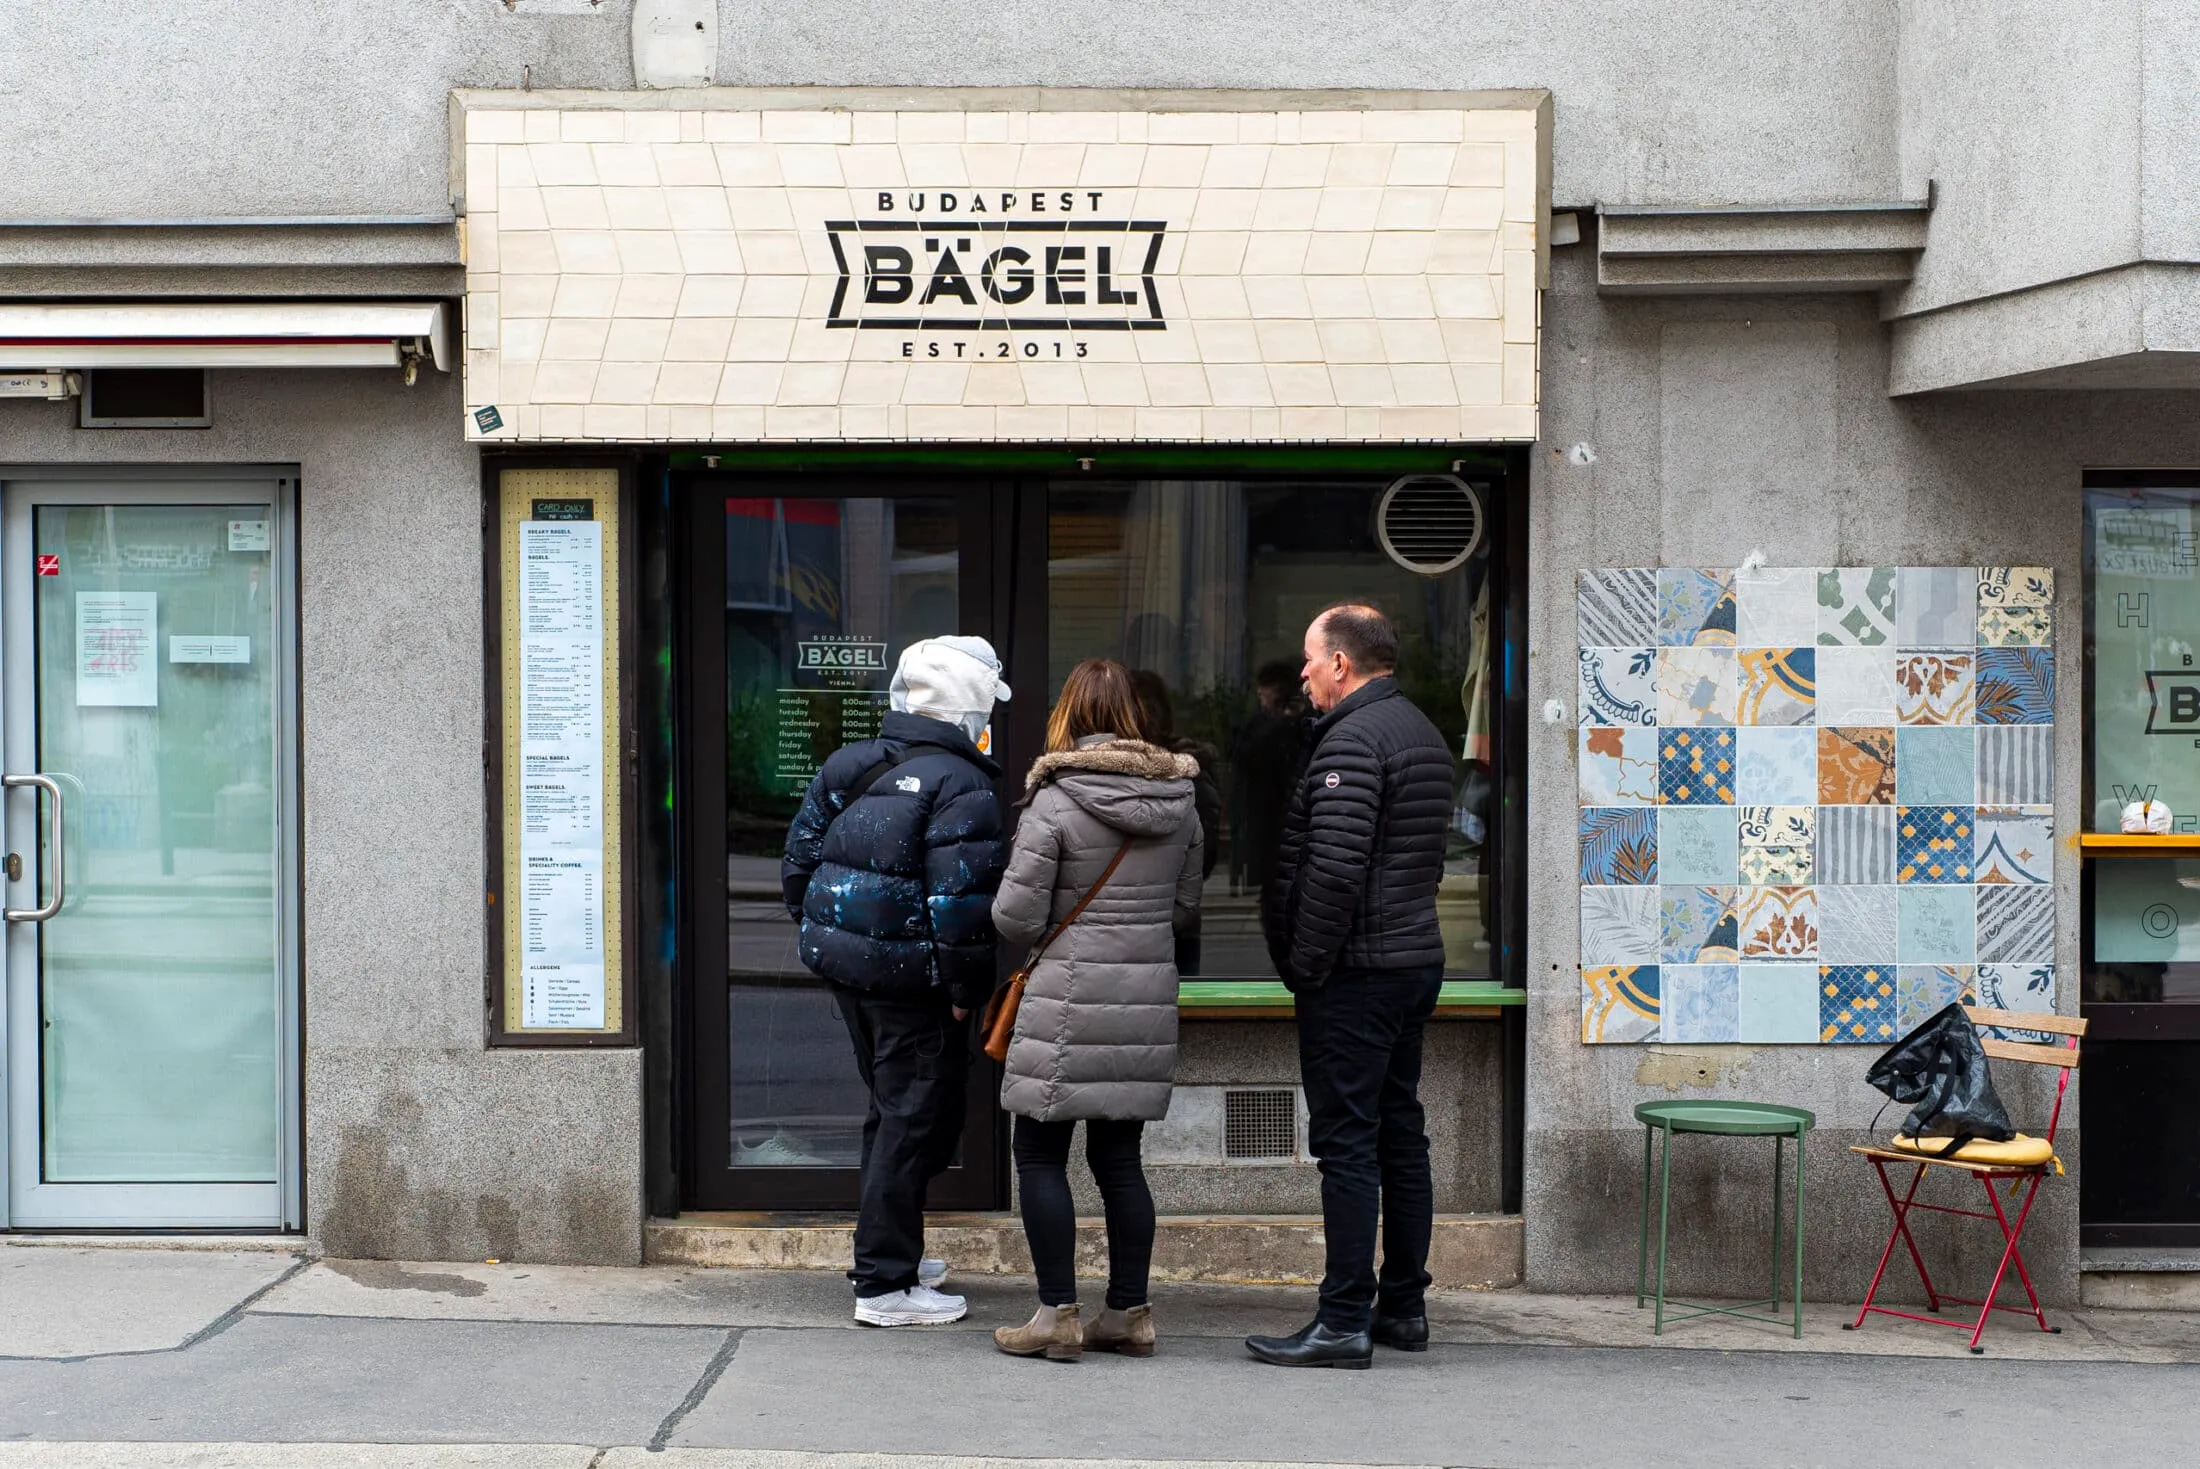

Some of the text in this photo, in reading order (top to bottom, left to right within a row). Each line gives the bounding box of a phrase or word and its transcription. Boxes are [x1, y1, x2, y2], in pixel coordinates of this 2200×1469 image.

[878, 192, 1103, 212] BUDAPEST
[864, 238, 1138, 305] BÄGEL
[902, 342, 1088, 358] EST.2013
[538, 503, 584, 513] CARD ONLY
[2118, 593, 2149, 628] H
[807, 646, 879, 665] BÄGEL
[779, 696, 809, 706] monday
[842, 698, 871, 706] 8:00am
[779, 708, 809, 717] tuesday
[842, 709, 871, 717] 8:00am
[779, 719, 820, 728] wednesday
[842, 720, 871, 728] 8:00am
[778, 730, 812, 739] thursday
[778, 740, 802, 750] friday
[778, 752, 811, 761] saturday
[778, 763, 804, 771] sunday
